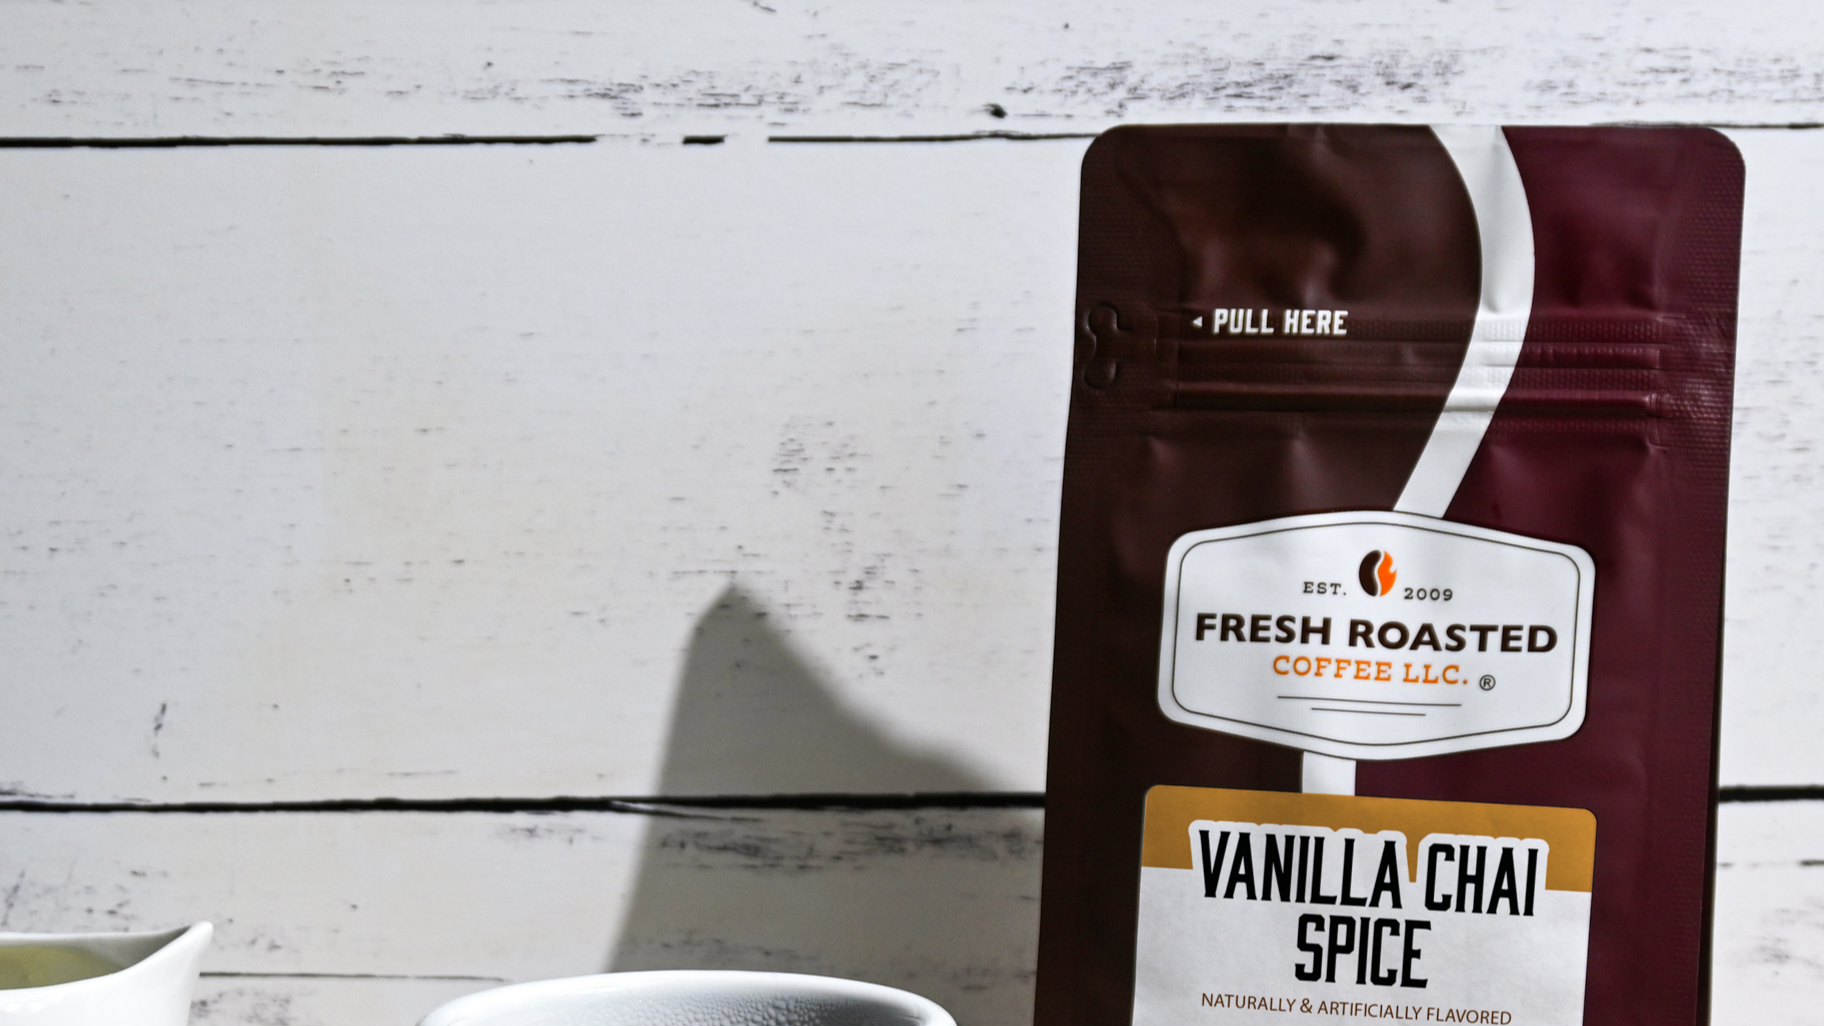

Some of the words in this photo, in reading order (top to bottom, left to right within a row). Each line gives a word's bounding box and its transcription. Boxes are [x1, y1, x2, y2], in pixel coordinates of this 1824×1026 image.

[1212, 309, 1274, 335] PULL
[1284, 310, 1348, 336] HERE
[1303, 581, 1347, 596] EST.
[1403, 587, 1453, 601] 2009
[1195, 613, 1332, 646] FRESH
[1349, 620, 1557, 652] ROASTED
[1273, 655, 1392, 682] COFFEE
[1403, 662, 1468, 685] LLC.
[1198, 830, 1403, 909] VANILLA
[1424, 843, 1538, 916] CHAI
[1294, 914, 1431, 989] SPICE
[1201, 992, 1297, 1014] NATURALLY
[1300, 997, 1314, 1014] &
[1317, 998, 1422, 1021] ARTIFICIALLY
[1426, 1006, 1512, 1026] FLAVORED
